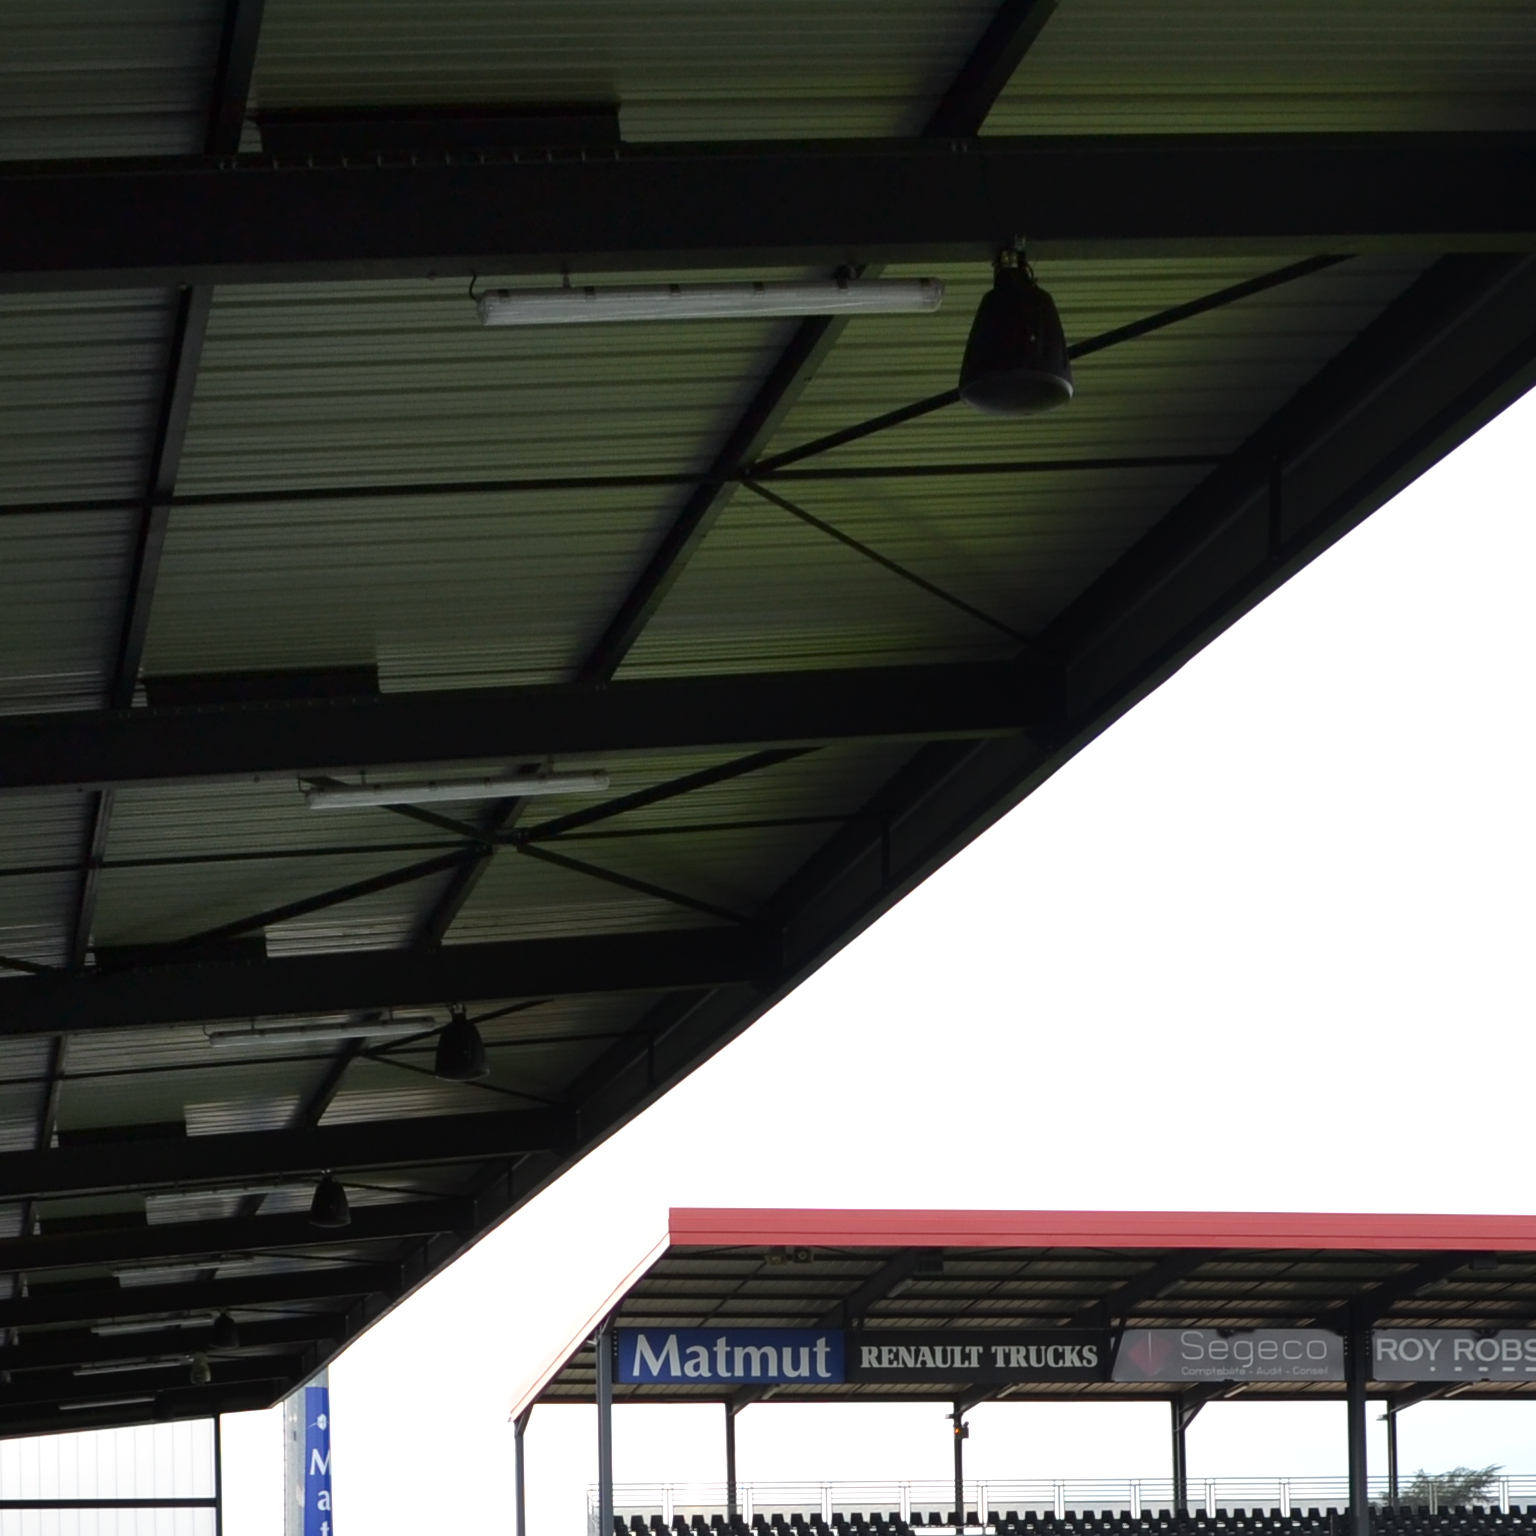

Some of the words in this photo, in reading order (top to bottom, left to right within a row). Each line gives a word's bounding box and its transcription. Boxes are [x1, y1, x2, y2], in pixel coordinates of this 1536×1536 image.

[632, 1333, 832, 1378] Matmut
[860, 1345, 983, 1369] RENAULT
[991, 1345, 1099, 1369] TRUCKS
[1180, 1330, 1328, 1368] Segeco
[1375, 1337, 1443, 1362] ROY
[1256, 1366, 1282, 1375] Audit
[1292, 1366, 1328, 1375] Conseil
